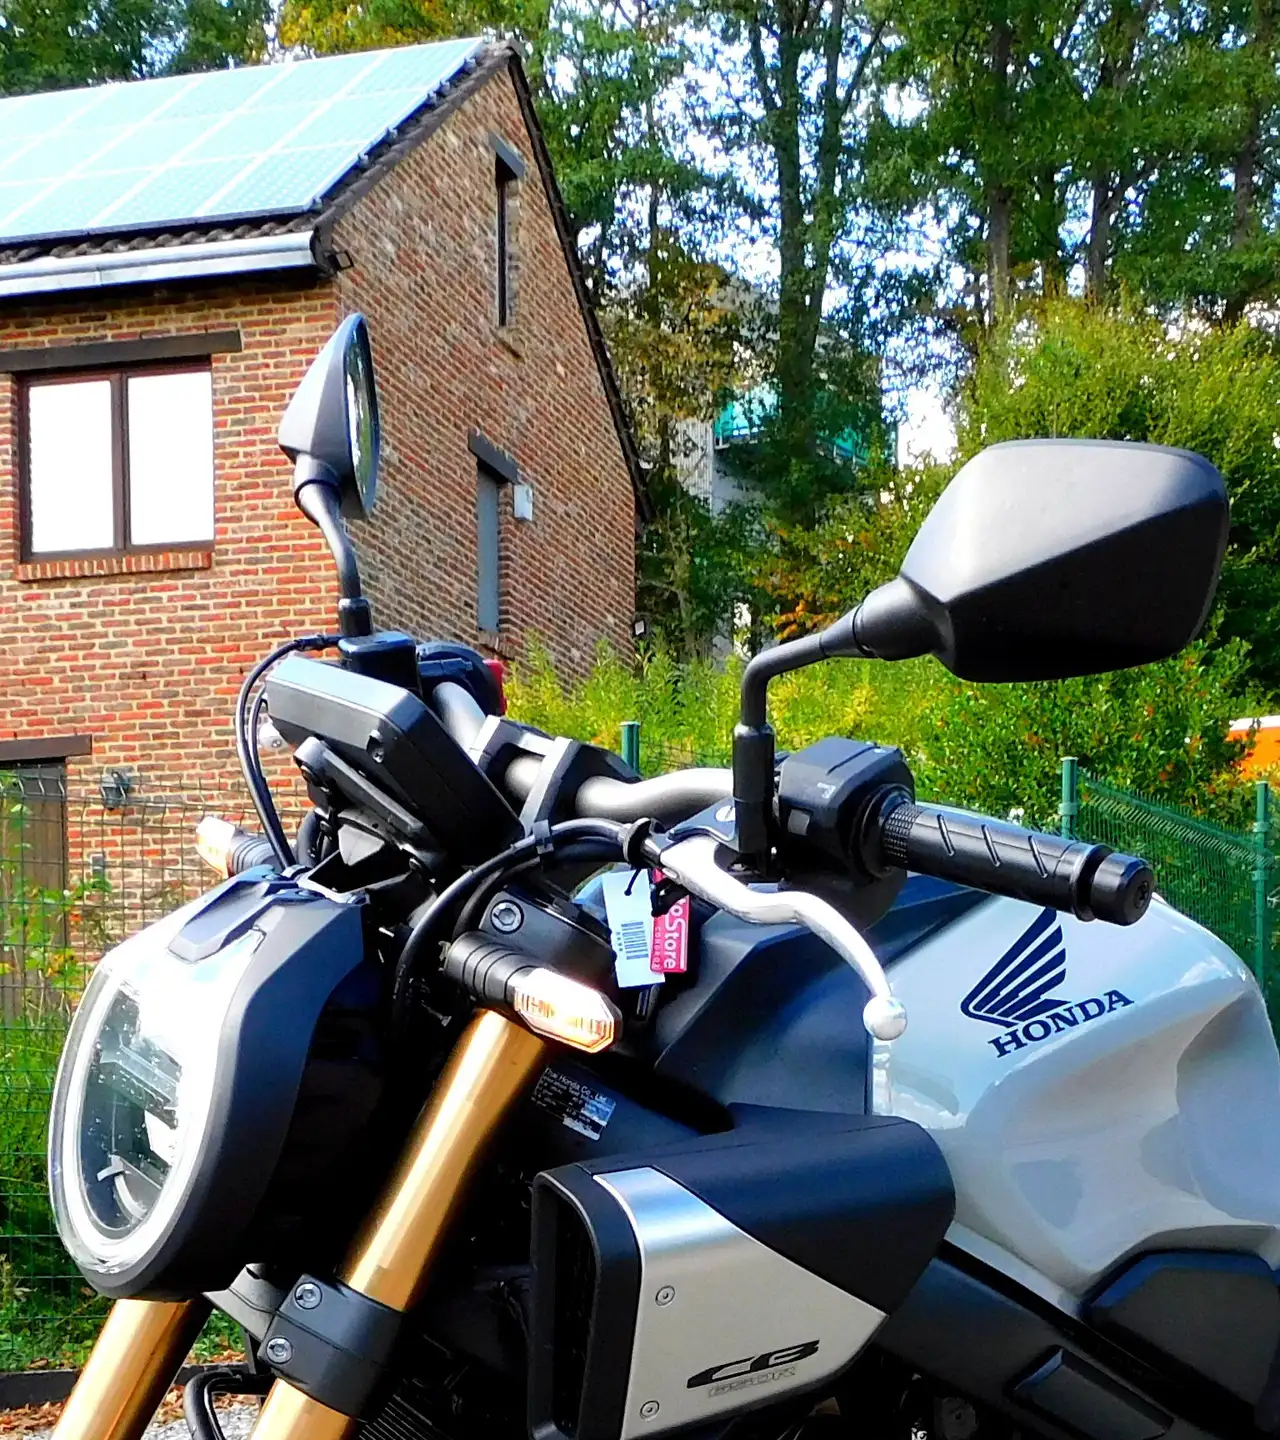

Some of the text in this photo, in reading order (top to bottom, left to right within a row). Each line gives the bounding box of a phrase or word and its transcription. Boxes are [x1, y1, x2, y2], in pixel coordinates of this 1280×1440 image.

[988, 989, 1135, 1058] HONDA
[560, 1074, 581, 1092] Honda
[687, 1339, 820, 1388] CB
